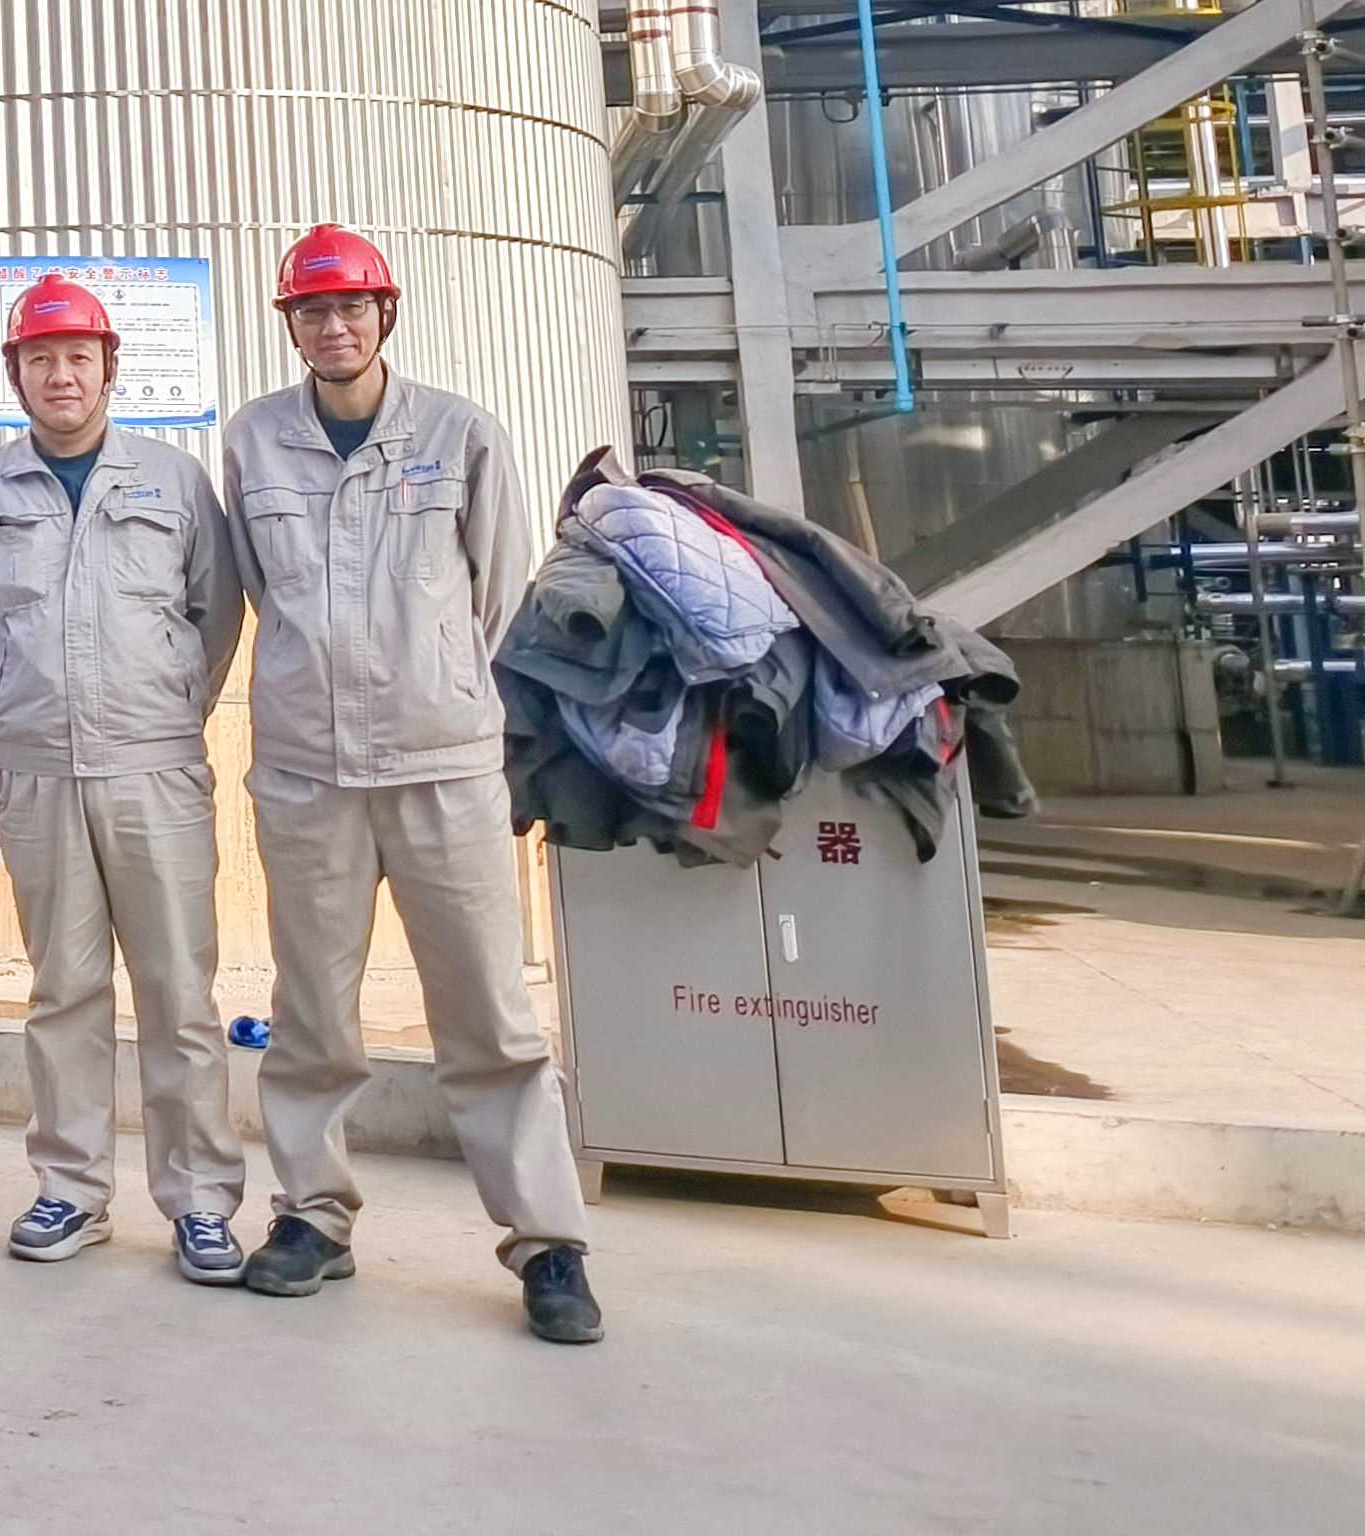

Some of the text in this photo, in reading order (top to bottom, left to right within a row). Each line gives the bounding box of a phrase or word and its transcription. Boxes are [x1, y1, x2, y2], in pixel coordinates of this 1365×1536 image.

[817, 821, 862, 865] 器
[672, 985, 879, 1027] Fire extinguisher
